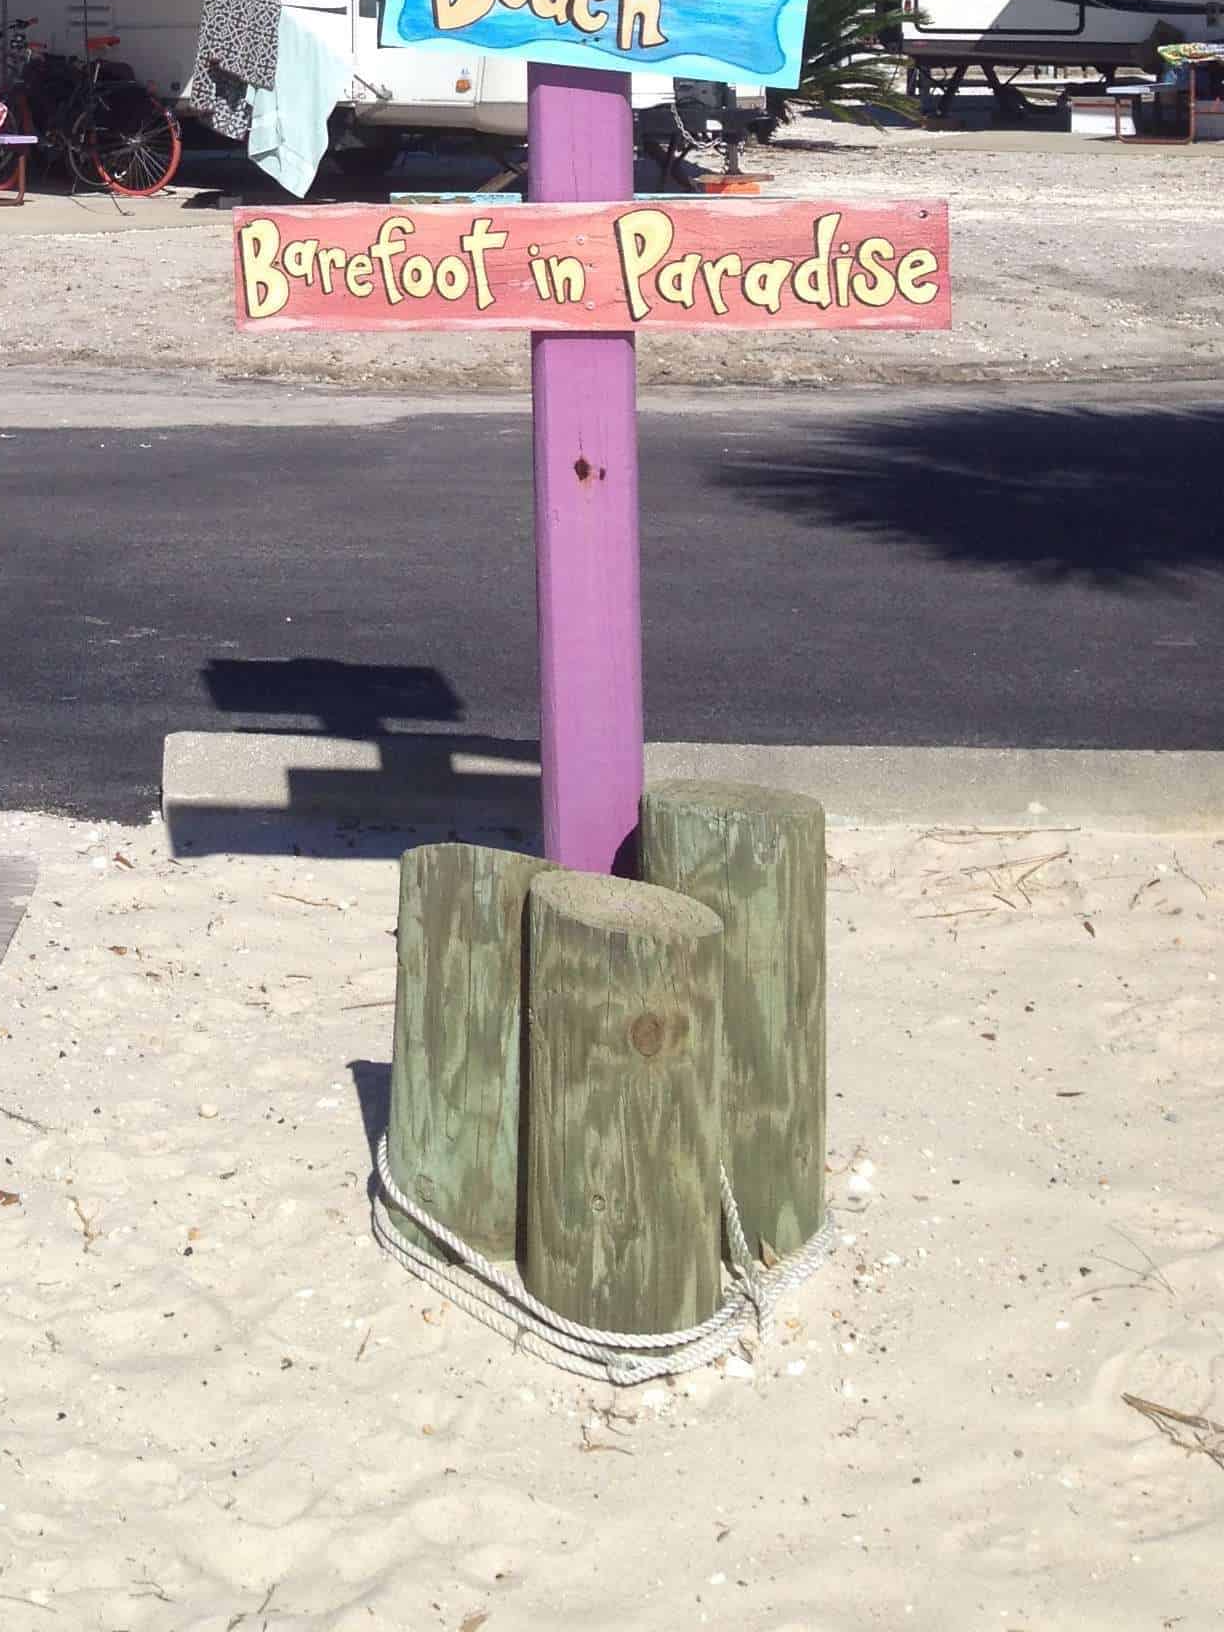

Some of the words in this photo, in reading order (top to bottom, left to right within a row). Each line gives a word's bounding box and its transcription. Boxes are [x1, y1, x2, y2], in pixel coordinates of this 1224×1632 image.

[238, 216, 509, 319] Barefoot
[528, 243, 586, 304] in
[614, 208, 939, 321] Paradise
